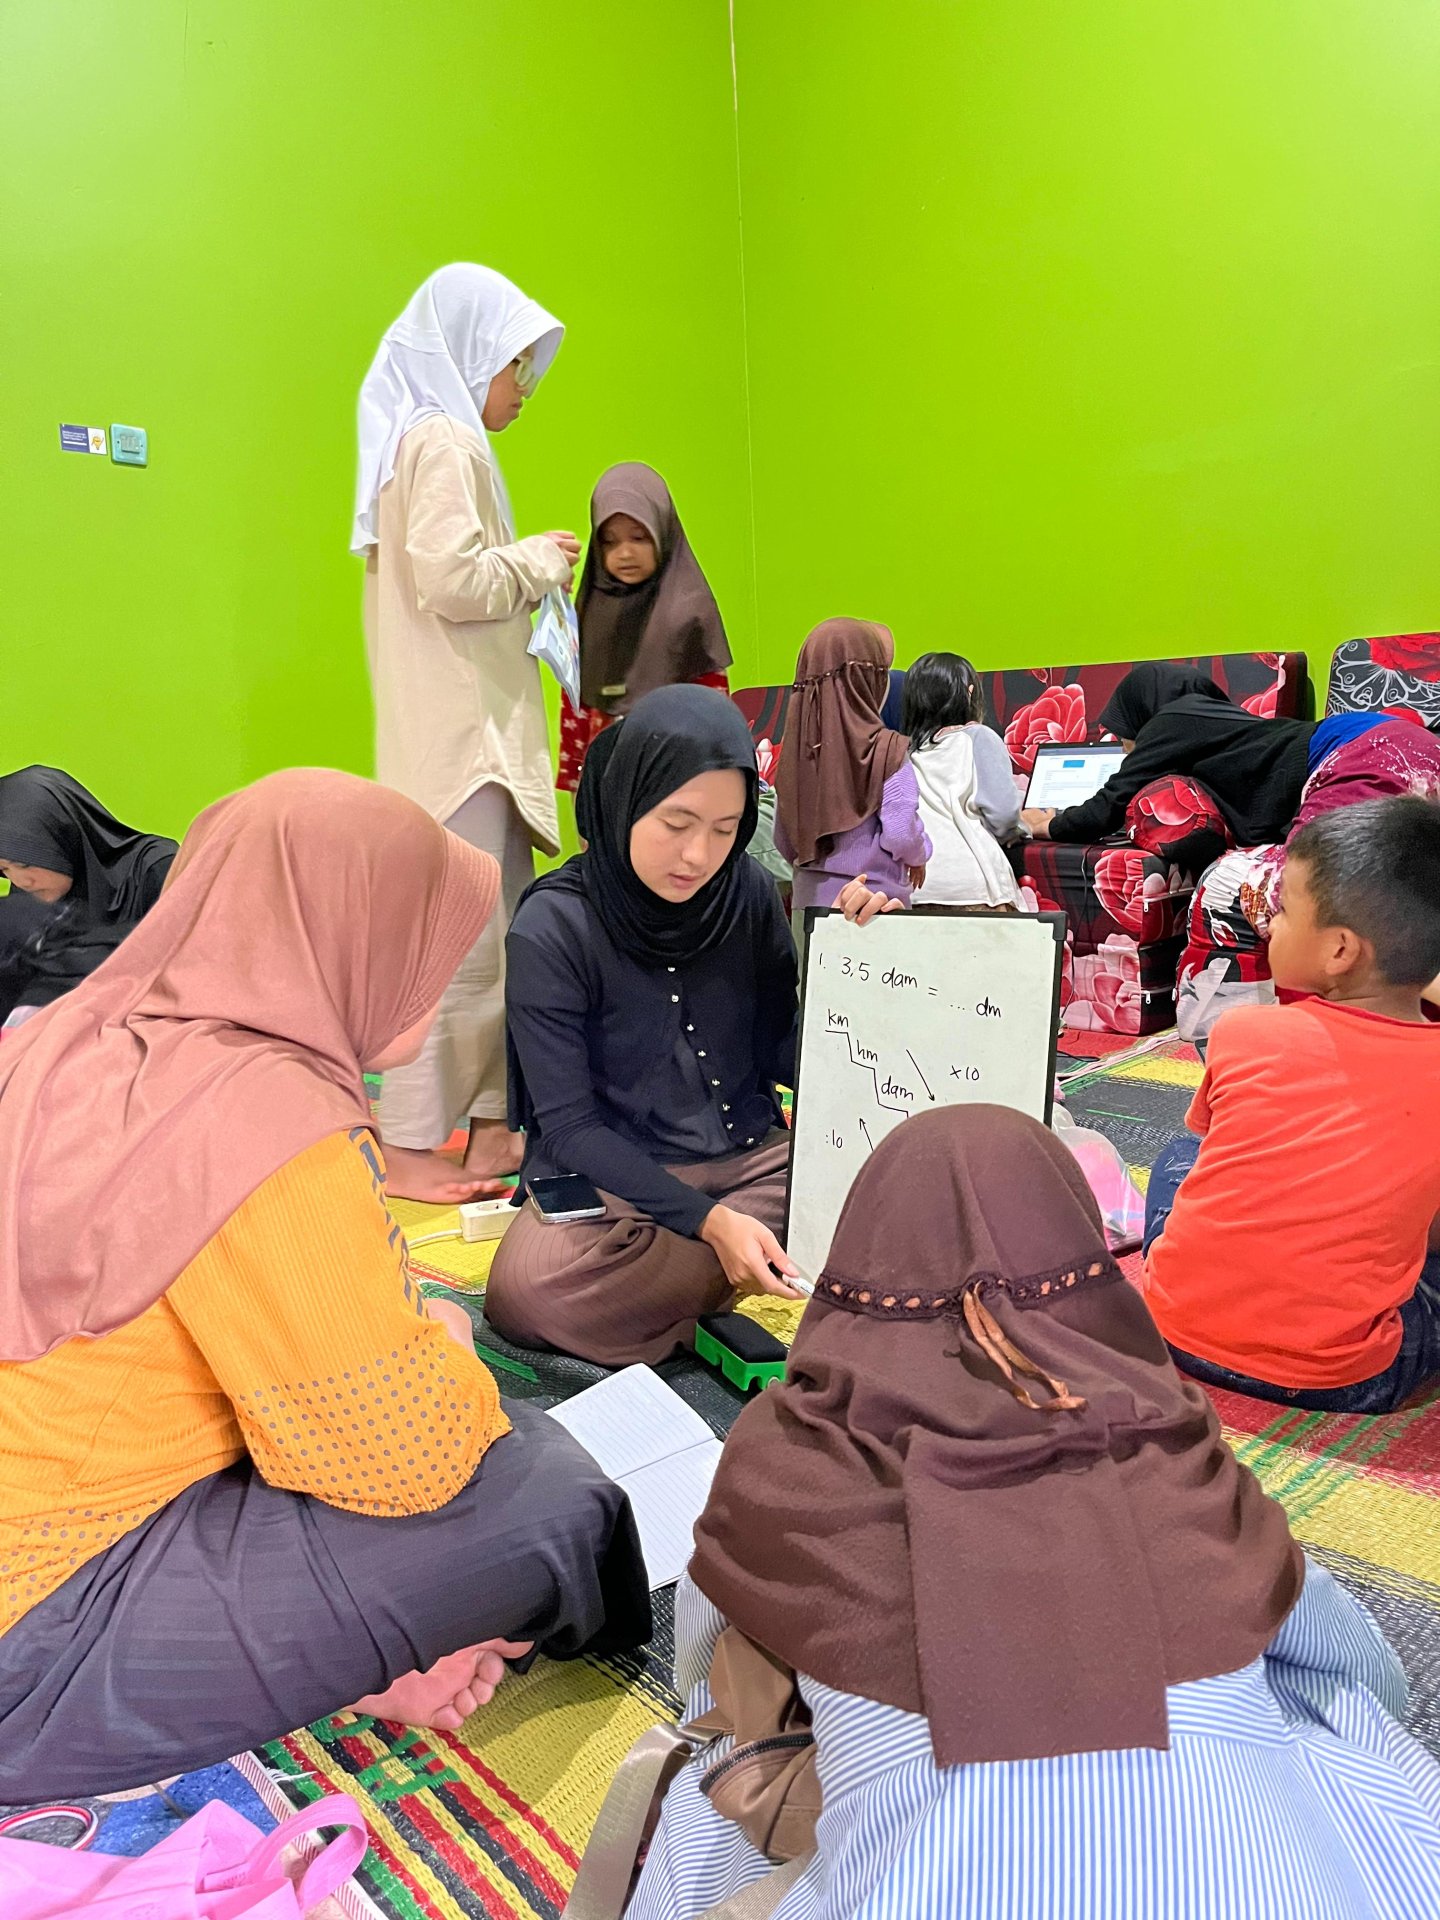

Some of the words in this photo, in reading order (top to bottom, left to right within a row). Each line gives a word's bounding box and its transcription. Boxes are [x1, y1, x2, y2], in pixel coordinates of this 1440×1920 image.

[841, 956, 871, 982] 3,5
[881, 967, 918, 989] dam
[976, 996, 1002, 1018] dm
[827, 1008, 849, 1028] km
[856, 1039, 878, 1063] hm
[881, 1075, 914, 1101] dam
